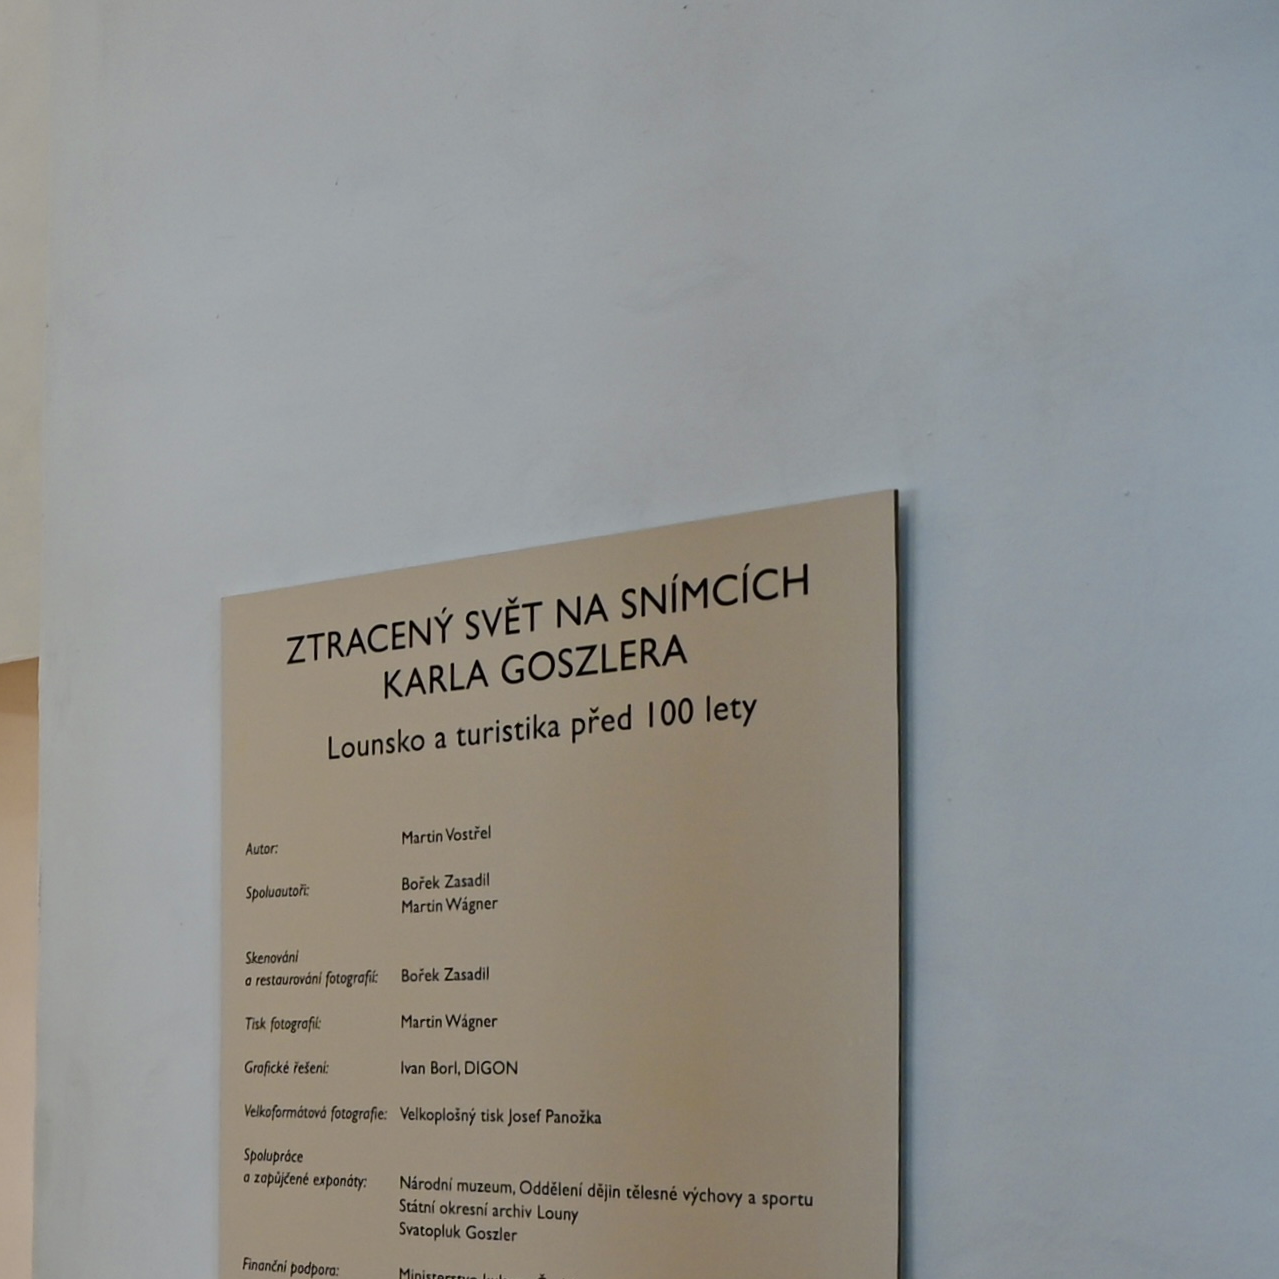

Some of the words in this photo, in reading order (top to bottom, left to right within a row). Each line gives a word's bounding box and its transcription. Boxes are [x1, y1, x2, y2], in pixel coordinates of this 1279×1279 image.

[287, 614, 454, 665] ZTRACENÝ
[466, 596, 543, 640] SVĚT
[557, 593, 609, 628] NA
[621, 563, 808, 619] SNÍMCÍCH
[384, 659, 489, 699] KARLA
[501, 634, 688, 684] GOSZLERA
[328, 729, 425, 760] Lounsko
[435, 732, 447, 749] a
[456, 714, 561, 747] turistika
[572, 704, 631, 744] před
[649, 697, 694, 728] 100
[706, 695, 757, 727] lety
[402, 830, 443, 845] Martin
[445, 825, 491, 841] Vostřel
[245, 842, 278, 856] Autor:
[402, 875, 440, 891] Bořek
[444, 872, 489, 888] Zasadil
[246, 884, 310, 903] Spoluautoři:
[402, 899, 443, 914] Martin
[445, 896, 498, 915] Wágner
[245, 950, 299, 964] Skenování
[245, 977, 252, 986] a
[256, 971, 322, 986] restaurování
[325, 969, 378, 988] fotografií:
[402, 968, 439, 982] Bořek
[444, 966, 489, 981] Zasadil
[245, 1017, 266, 1030] Tisk
[270, 1016, 321, 1033] fotografií:
[401, 1014, 442, 1028] Martin
[445, 1013, 498, 1032] Wágner
[245, 1060, 289, 1077] Grafické
[294, 1061, 329, 1074] řešení:
[401, 1060, 425, 1075] Ivan
[465, 1060, 518, 1075] DIGON
[245, 1104, 327, 1121] Velkoformátová
[331, 1105, 387, 1123] fotografie:
[400, 1107, 476, 1126] Velkoplošný
[481, 1108, 504, 1122] tisk
[507, 1108, 541, 1127] Josef
[546, 1109, 602, 1124] Panožka
[244, 1148, 303, 1166] Spolupráce
[243, 1173, 250, 1183] a
[254, 1171, 309, 1188] zapůjčené
[313, 1174, 367, 1192] exponáty:
[400, 1176, 453, 1191] Národní
[457, 1182, 516, 1196] muzeum,
[519, 1180, 583, 1197] Oddělení
[588, 1183, 620, 1202] dějin
[626, 1184, 677, 1201] tělesné
[683, 1186, 743, 1208] výchovy
[748, 1194, 756, 1204] a
[762, 1194, 813, 1210] sportu
[399, 1198, 435, 1214] Státní
[440, 1201, 488, 1216] okresní
[492, 1203, 532, 1218] archiv
[538, 1205, 578, 1225] Louny
[399, 1221, 461, 1241] Svatopluk
[466, 1225, 518, 1242] Goszler
[242, 1257, 287, 1273] Finanční
[290, 1261, 339, 1279] podpora:
